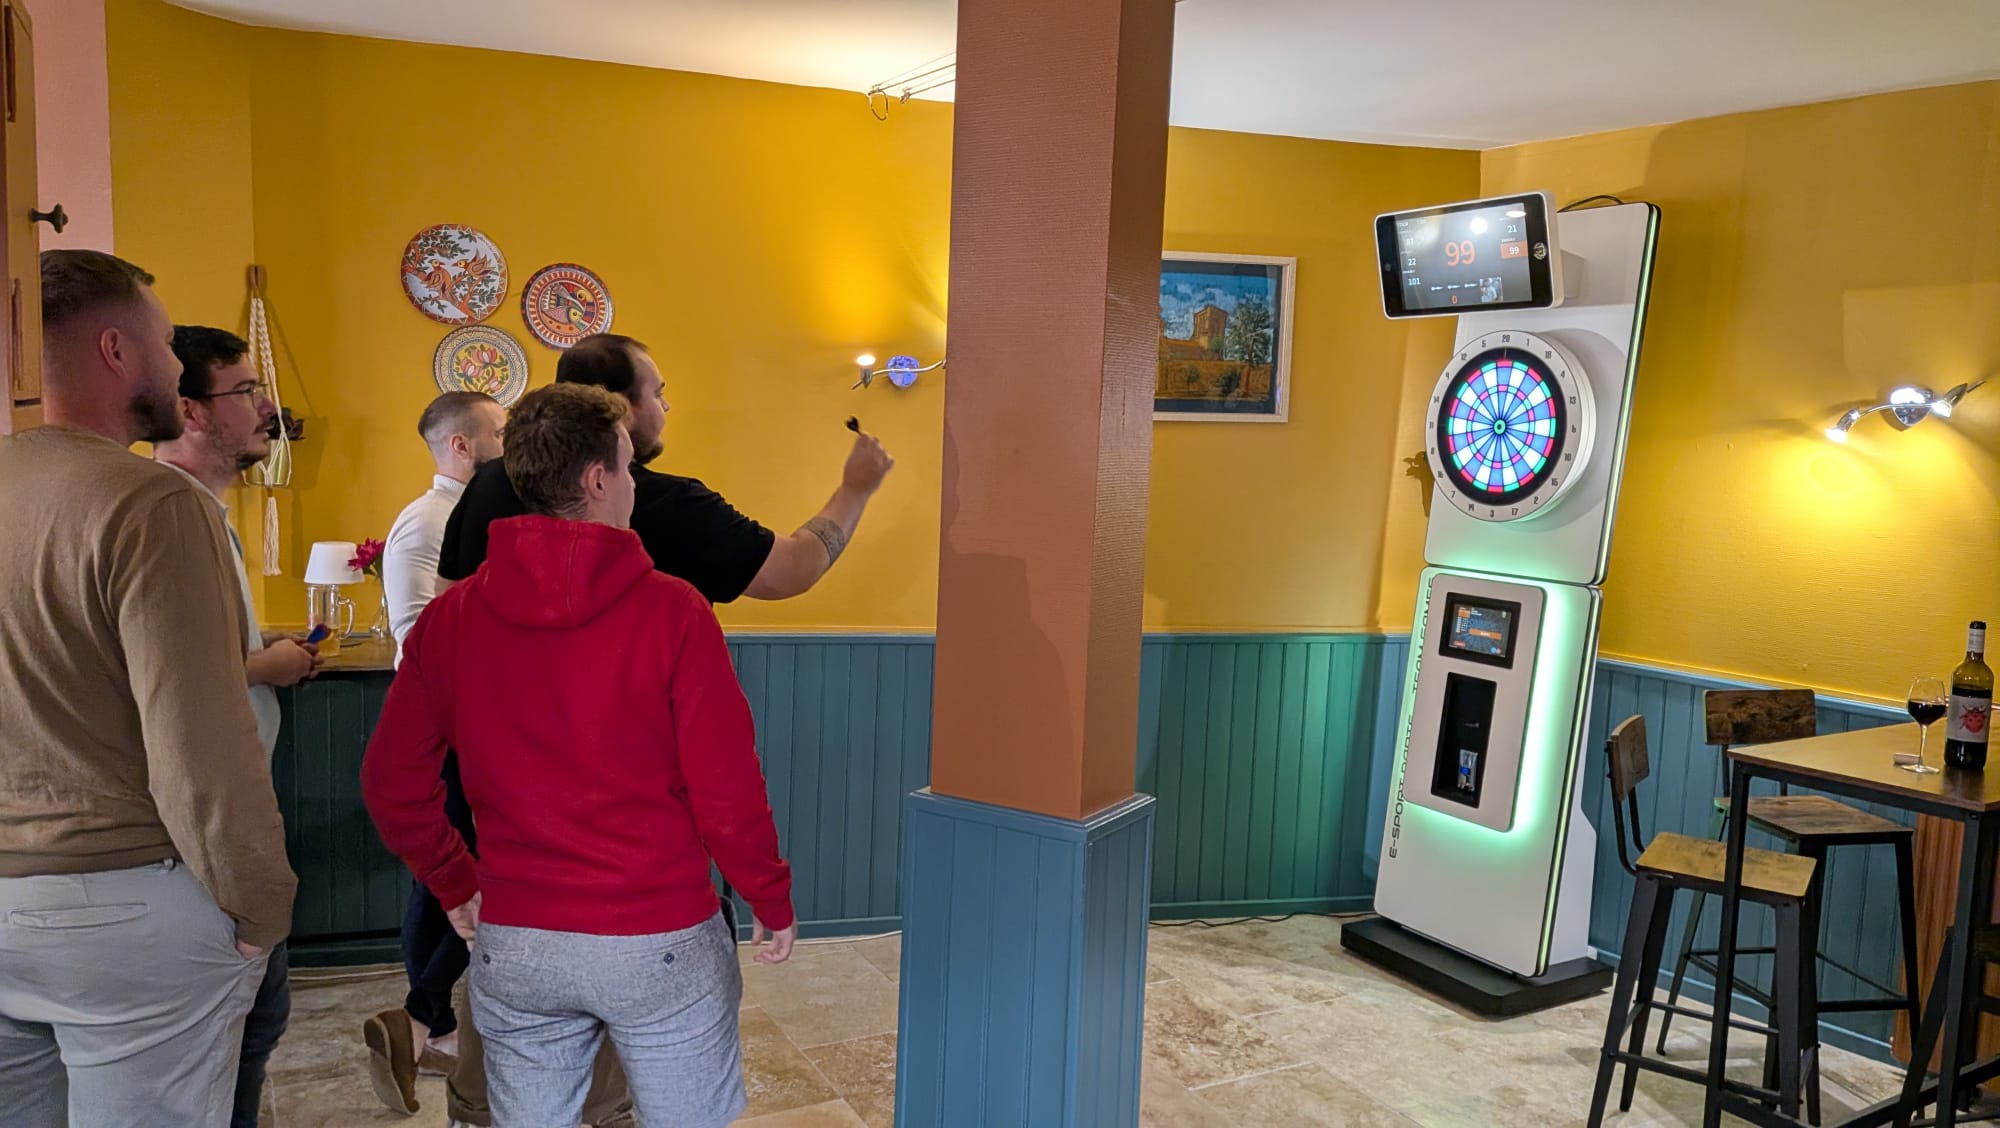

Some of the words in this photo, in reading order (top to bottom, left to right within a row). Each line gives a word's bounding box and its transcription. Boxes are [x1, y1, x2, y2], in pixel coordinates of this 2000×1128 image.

[1507, 225, 1518, 233] 21
[1445, 240, 1475, 267] 99
[1509, 246, 1520, 255] 99
[1407, 258, 1417, 266] 22
[1407, 277, 1421, 286] 101
[1502, 334, 1511, 343] 20
